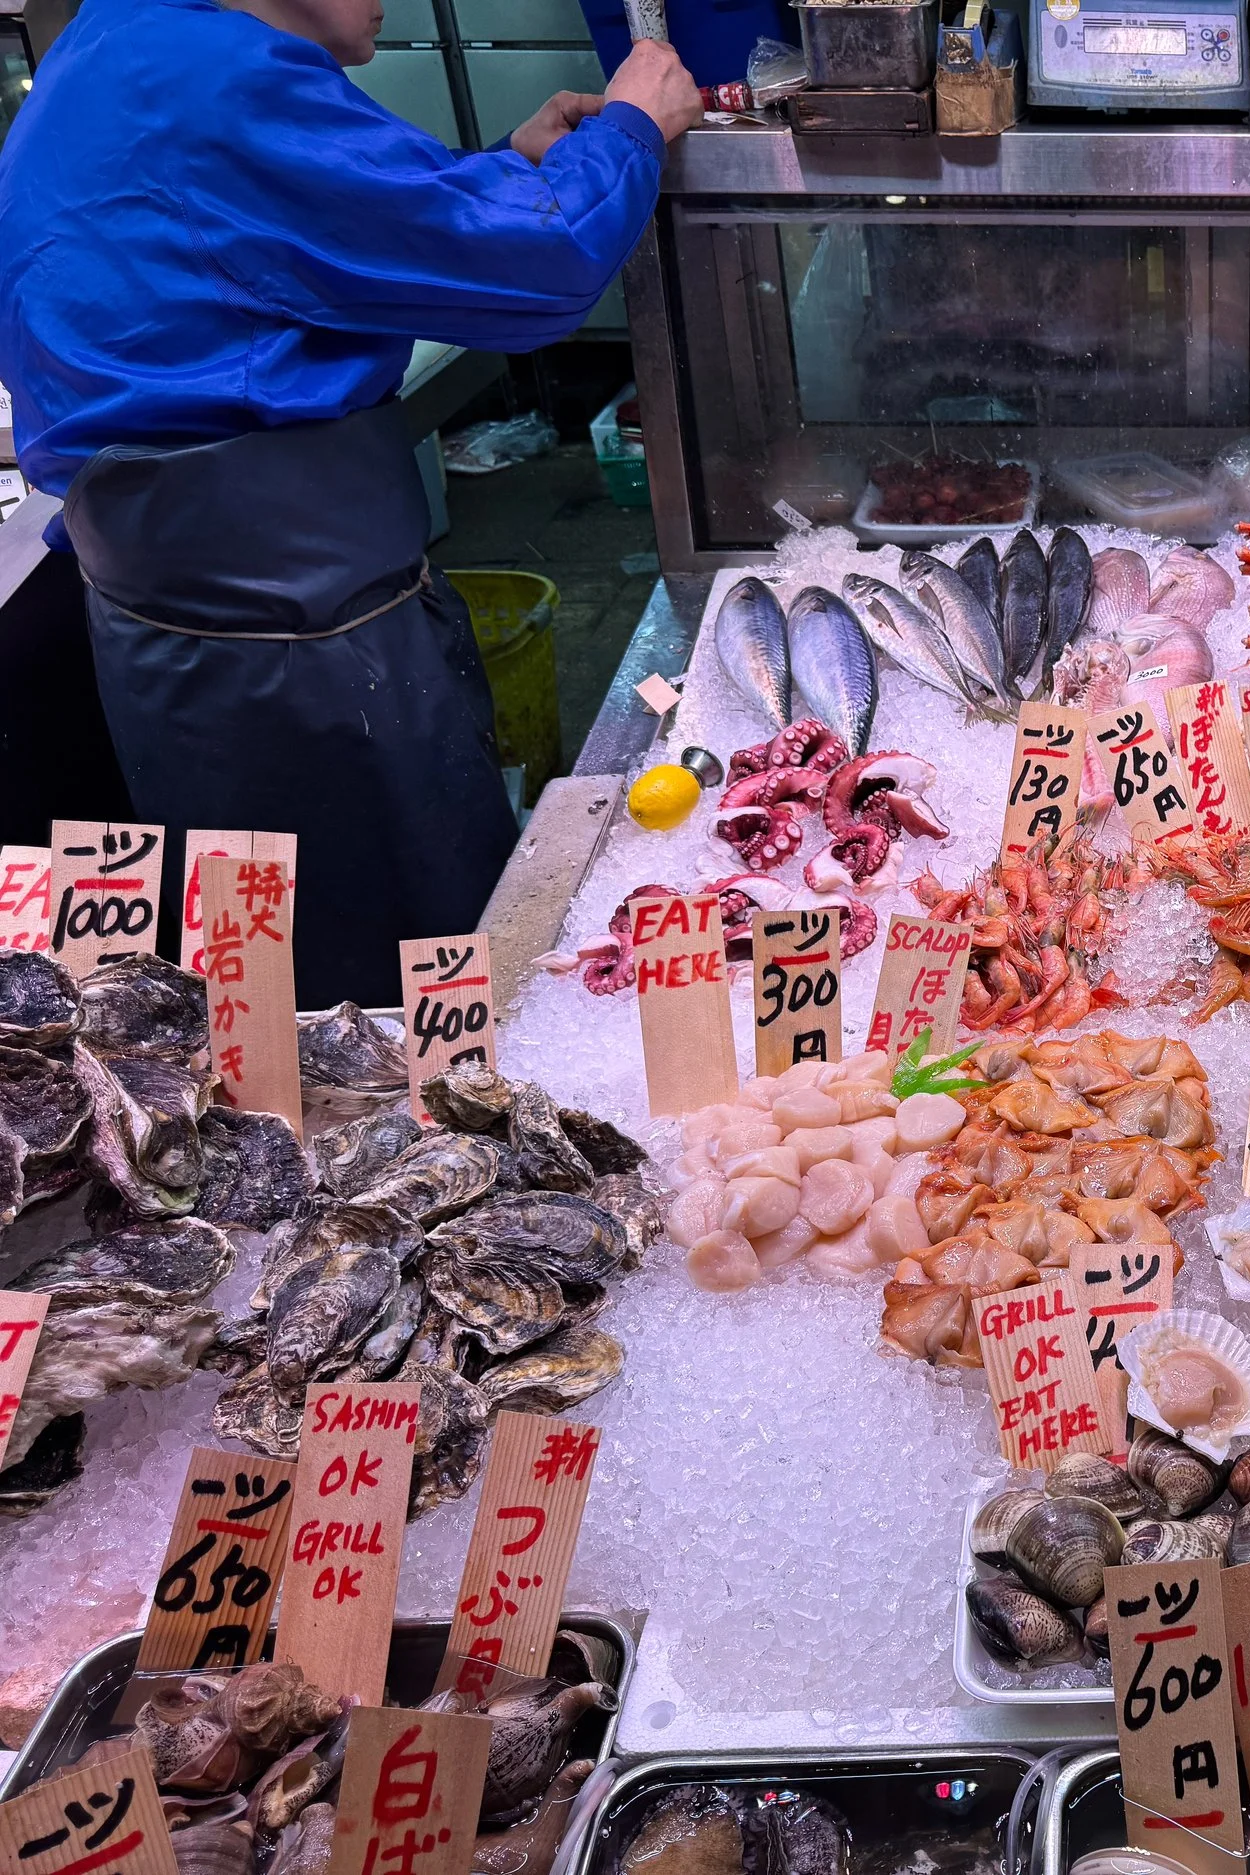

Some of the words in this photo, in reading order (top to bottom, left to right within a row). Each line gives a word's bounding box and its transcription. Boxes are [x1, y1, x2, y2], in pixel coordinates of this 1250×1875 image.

[1009, 759, 1070, 806] 130
[1113, 746, 1168, 807] 650
[1027, 804, 1063, 836] 円
[1153, 785, 1187, 822] 円
[0, 863, 51, 919] EA
[236, 863, 287, 942] 特大
[51, 886, 154, 954] 1000
[632, 898, 720, 947] EAT
[637, 950, 723, 995] HERE
[757, 964, 838, 1028] 300
[414, 996, 488, 1058] 400
[793, 1028, 827, 1064] 円
[980, 1288, 1076, 1341] GRILL
[1013, 1335, 1065, 1383] OK
[999, 1379, 1062, 1431] EAT
[1018, 1403, 1098, 1461] HERE
[319, 1450, 383, 1497] OK
[293, 1520, 385, 1566] GRILL
[154, 1533, 271, 1613] 650
[312, 1565, 363, 1605] OK
[191, 1625, 250, 1674] 円
[1123, 1642, 1223, 1732] 600
[1172, 1740, 1219, 1800] 円
